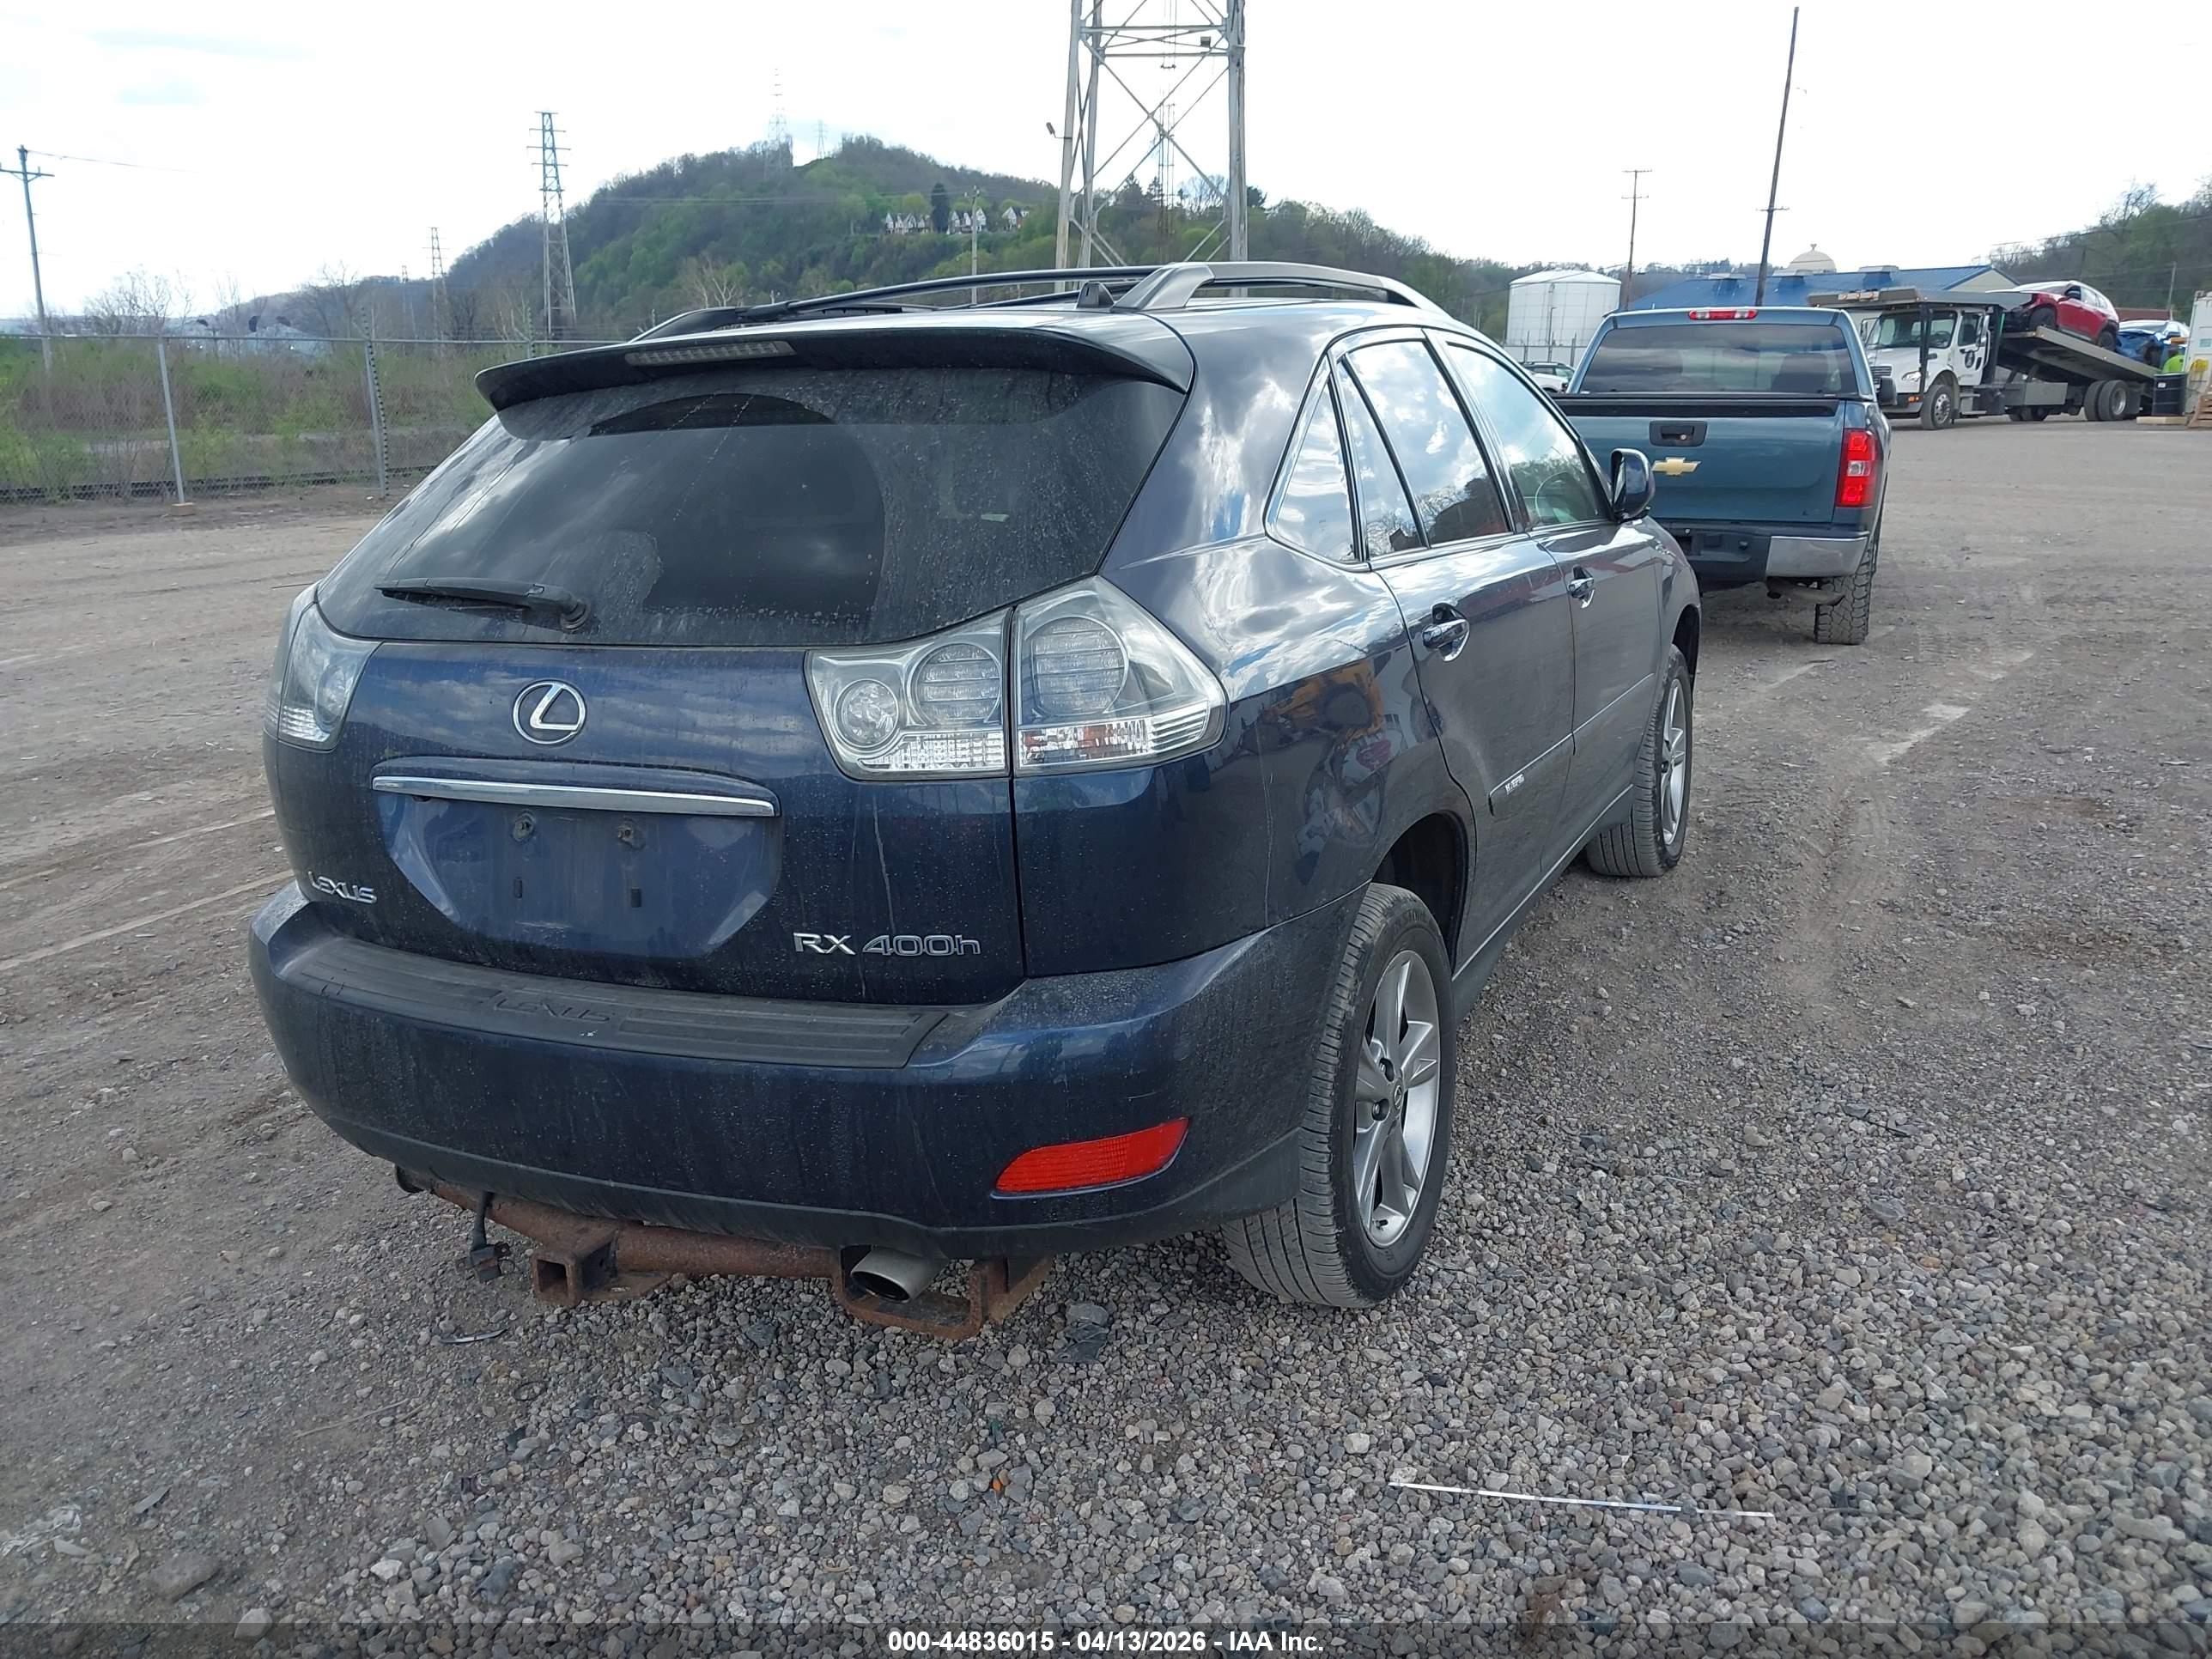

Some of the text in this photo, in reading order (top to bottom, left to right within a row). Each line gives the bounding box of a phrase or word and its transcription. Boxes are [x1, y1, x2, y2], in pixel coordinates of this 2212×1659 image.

[307, 871, 377, 904] LEXUS
[793, 932, 981, 956] RX 400h
